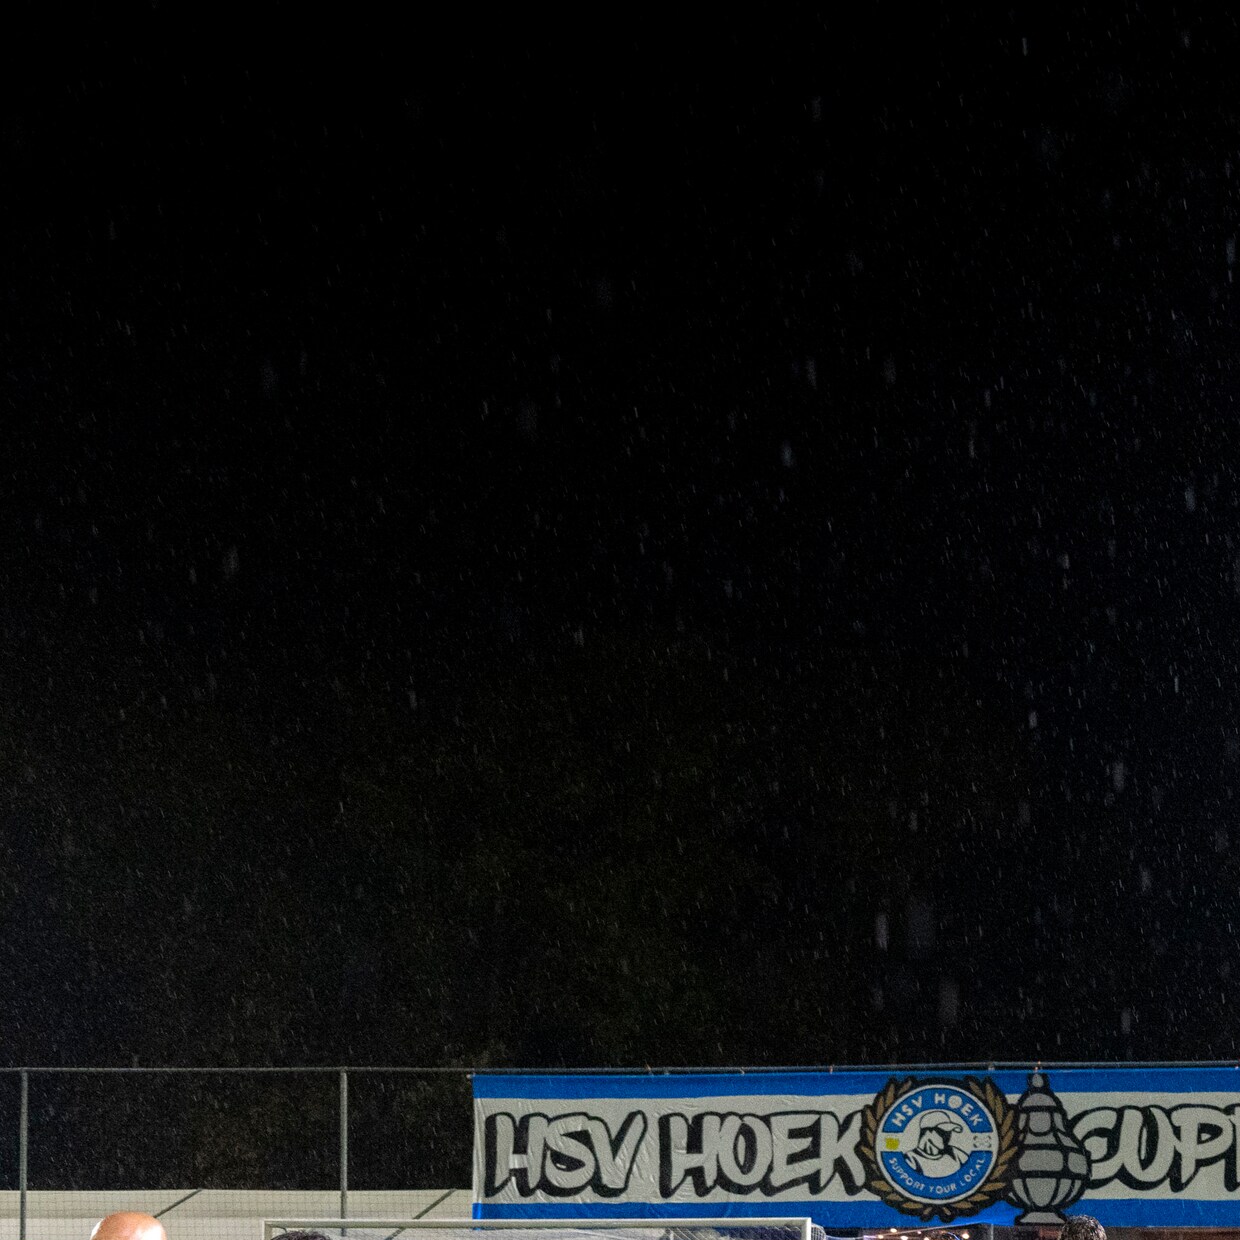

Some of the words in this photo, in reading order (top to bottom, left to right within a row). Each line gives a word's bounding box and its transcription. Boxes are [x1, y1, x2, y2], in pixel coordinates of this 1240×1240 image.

[891, 1094, 923, 1127] HSV
[933, 1092, 984, 1127] HOEK
[484, 1110, 648, 1198] HSV
[658, 1110, 868, 1199] HOEK
[888, 1157, 926, 1191] SUPPORT
[929, 1183, 957, 1195] YOUR
[959, 1157, 986, 1188] LOCAL
